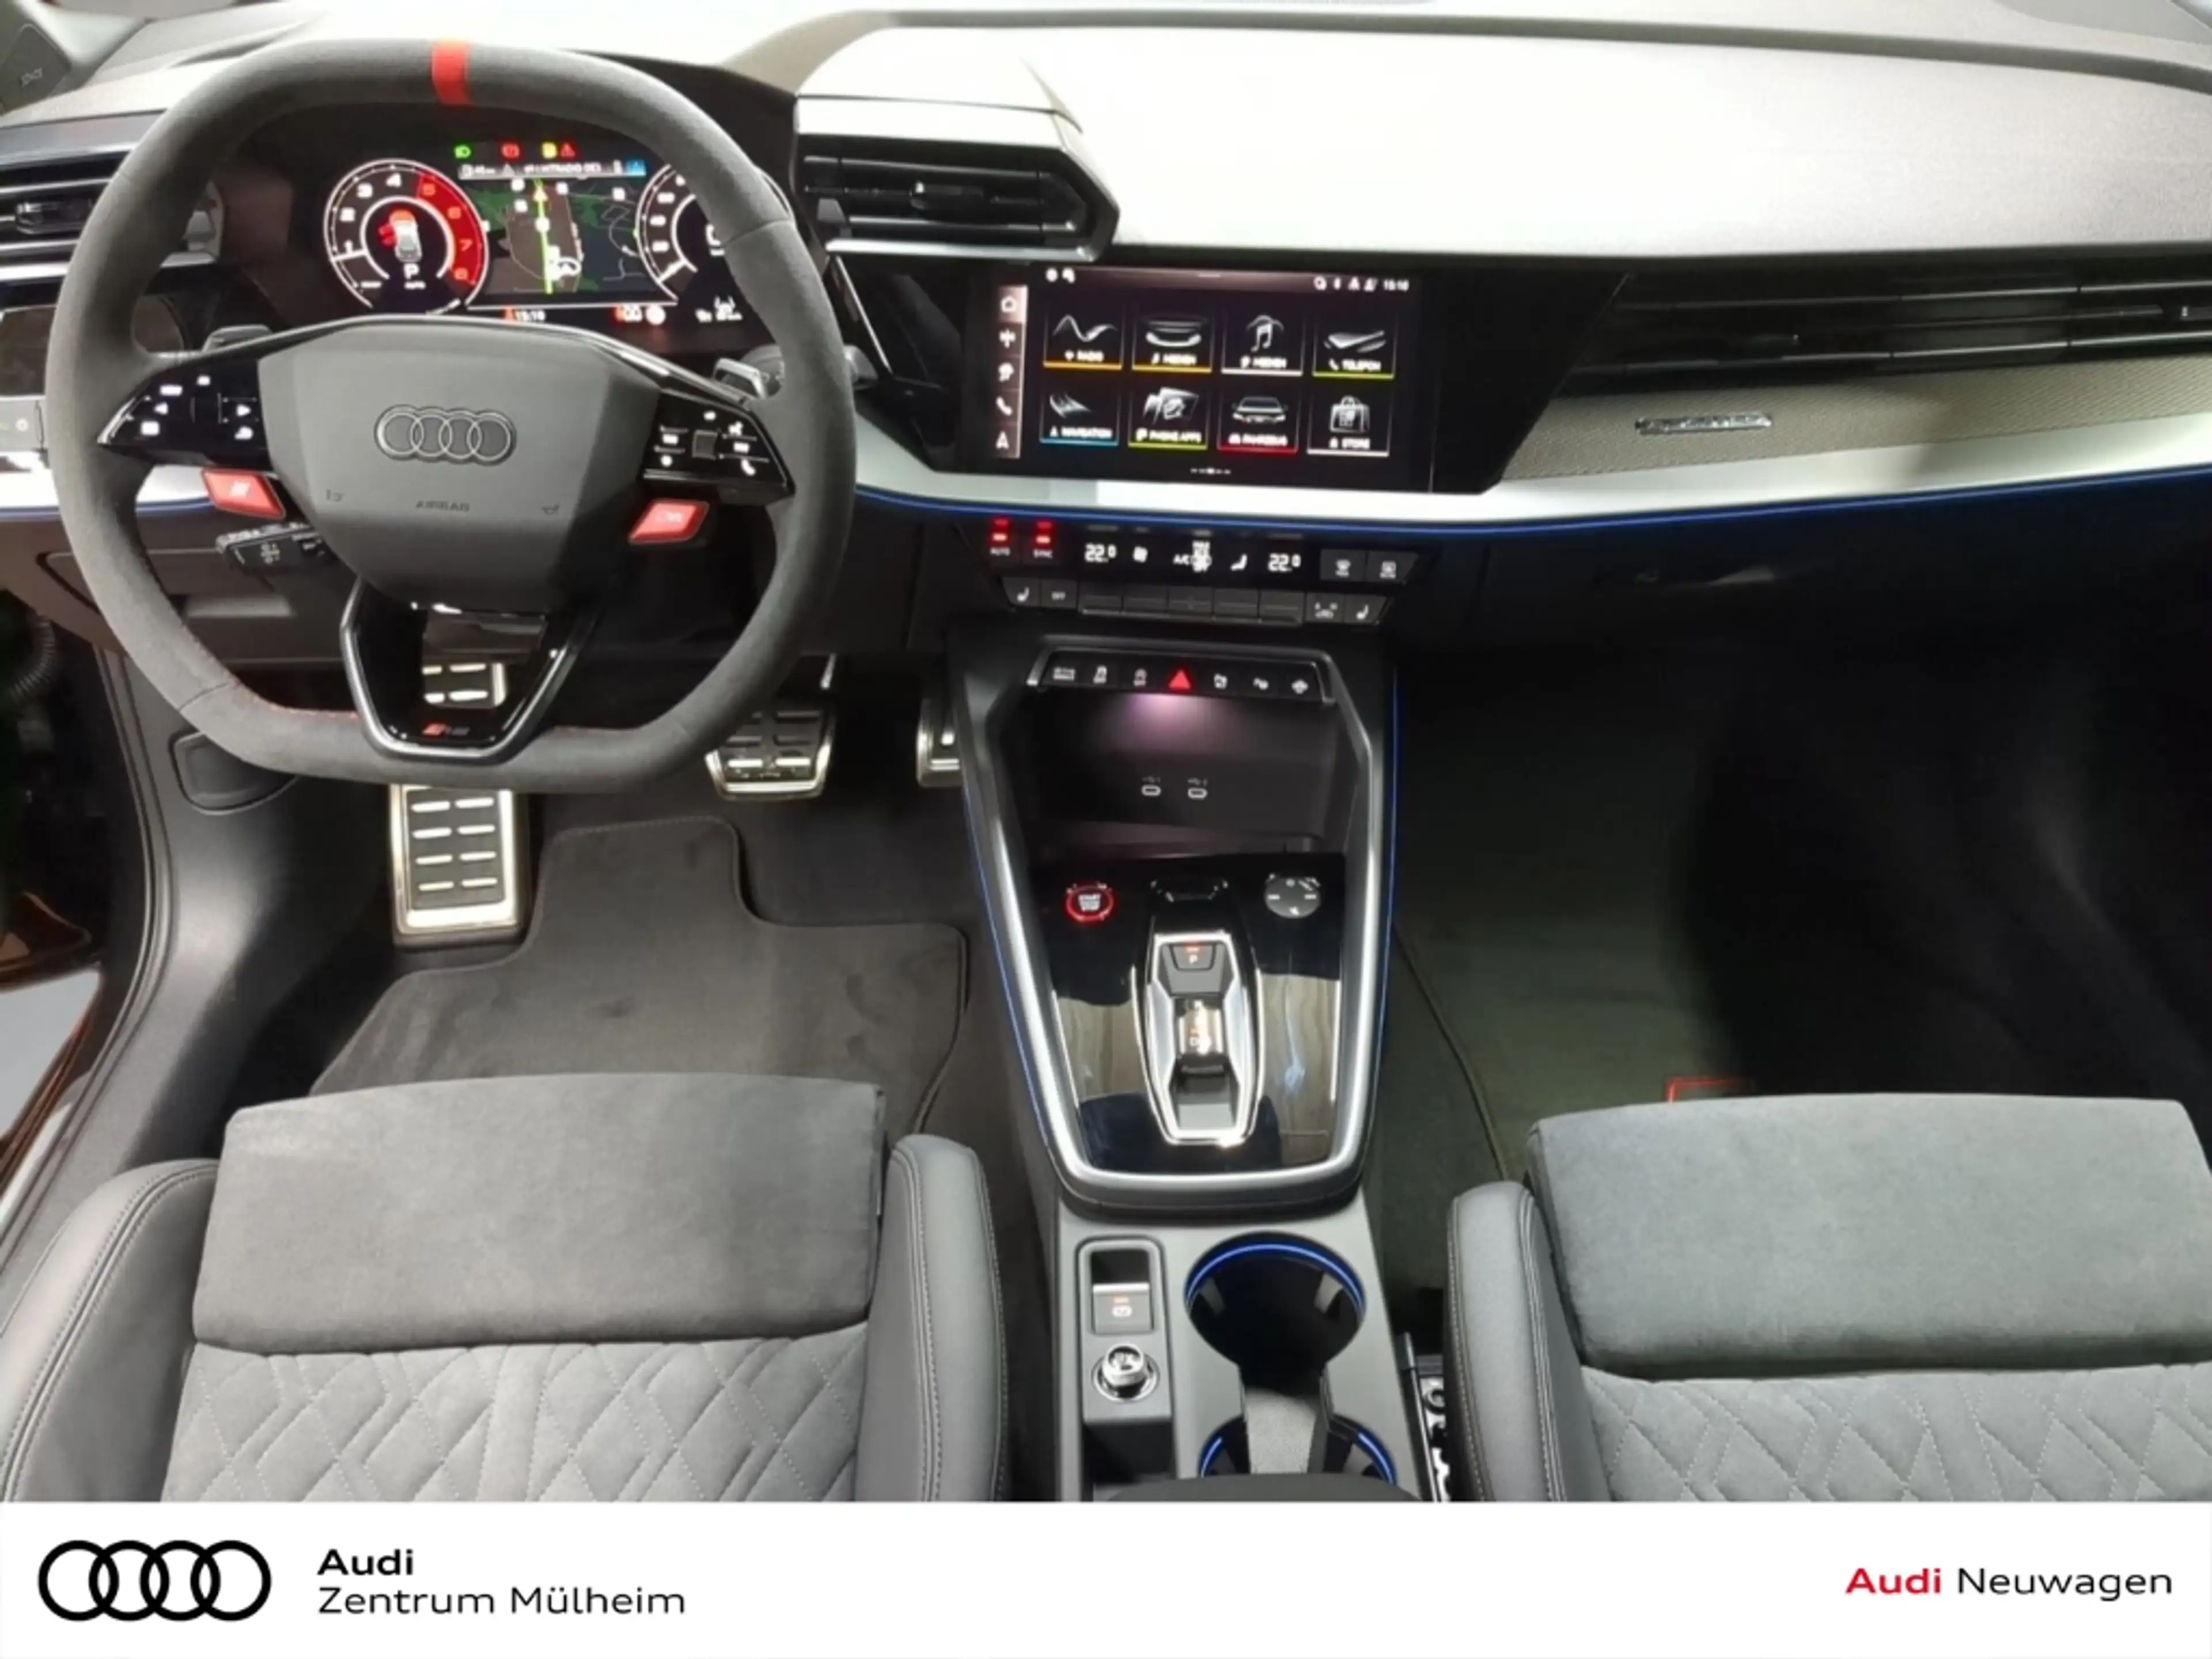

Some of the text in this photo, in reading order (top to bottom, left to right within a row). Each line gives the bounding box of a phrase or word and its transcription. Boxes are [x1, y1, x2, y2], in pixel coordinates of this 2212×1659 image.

[404, 263, 419, 279] P
[1342, 359, 1381, 372] TELEFON
[1341, 438, 1370, 450] STORE
[415, 499, 471, 512] AIRBAG
